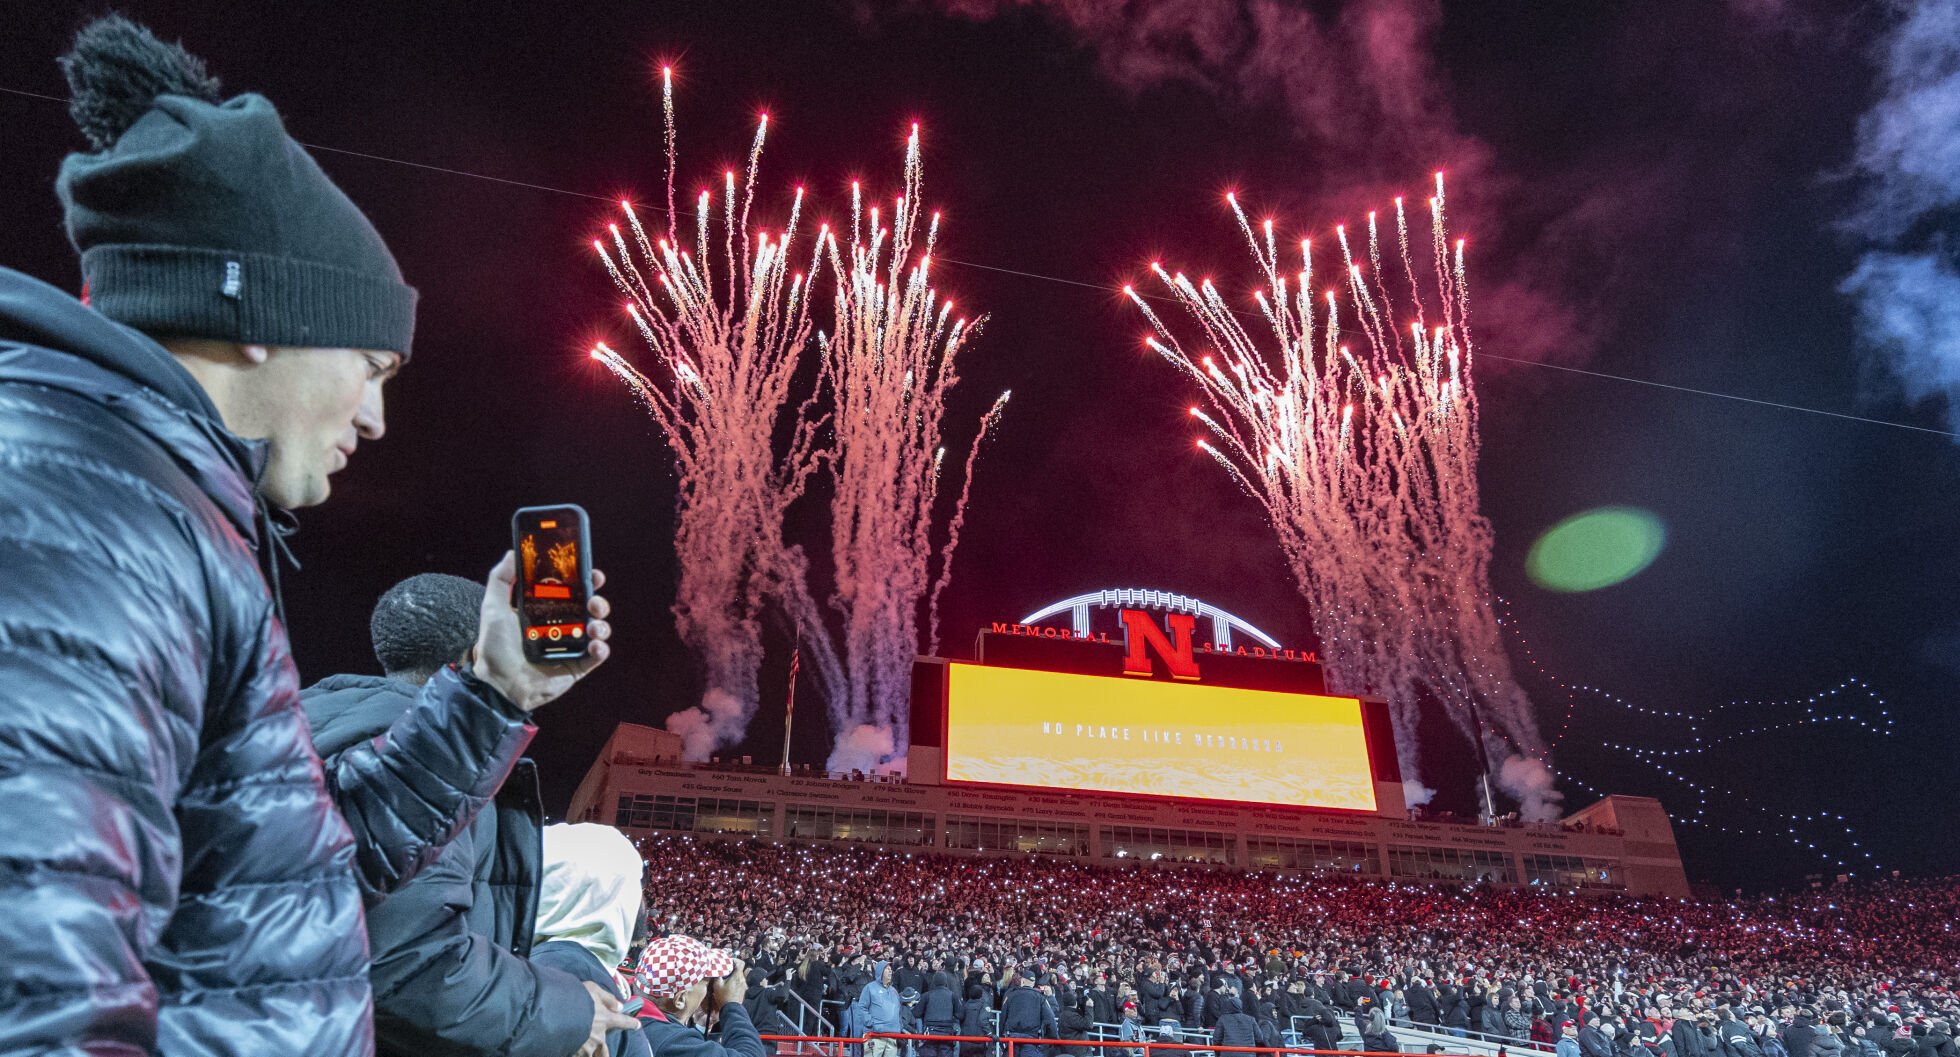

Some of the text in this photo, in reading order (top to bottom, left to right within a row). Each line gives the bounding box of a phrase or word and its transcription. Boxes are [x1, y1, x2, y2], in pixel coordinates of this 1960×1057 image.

[992, 622, 1316, 662] MEMORIAL STADIUM
[1119, 609, 1200, 680] N
[1043, 722, 1063, 735] NO
[1076, 724, 1130, 741] PLACE
[1143, 730, 1182, 745] LIKE
